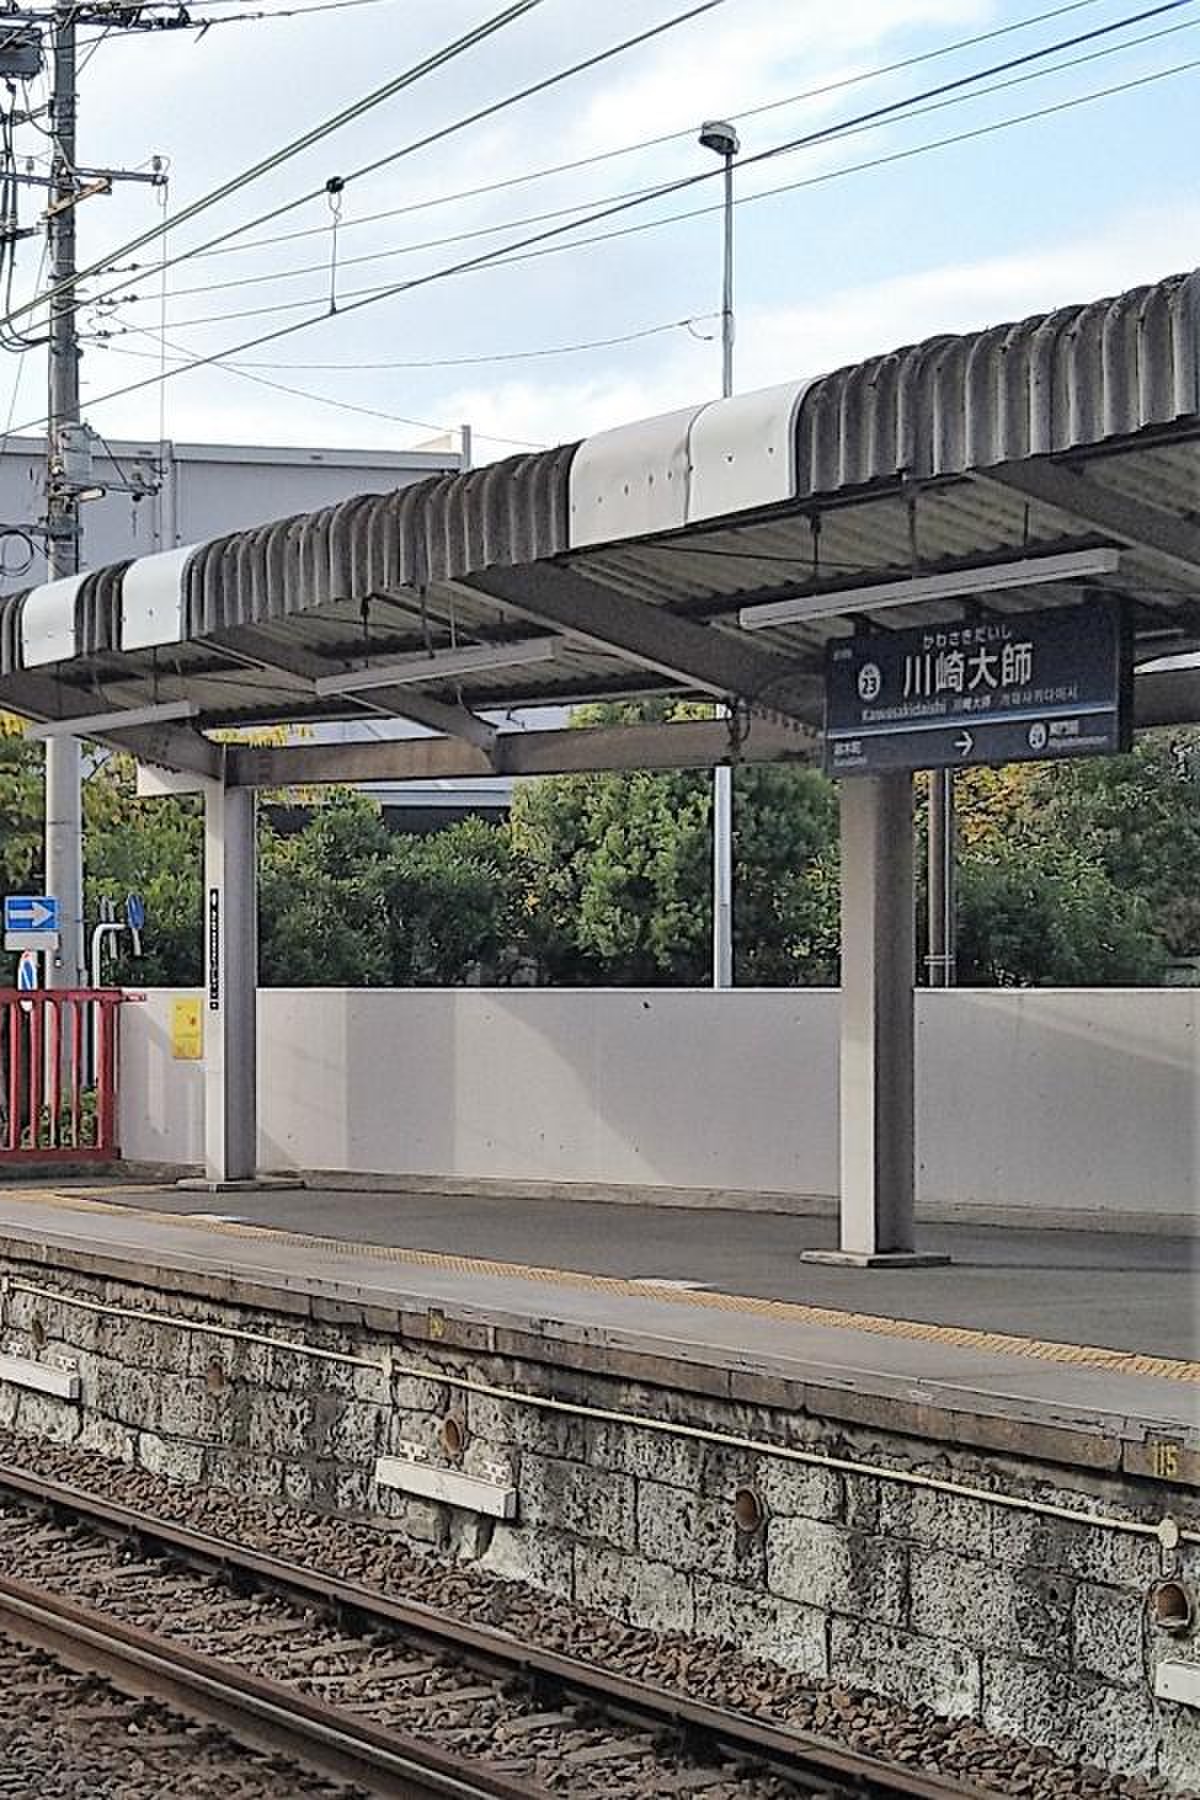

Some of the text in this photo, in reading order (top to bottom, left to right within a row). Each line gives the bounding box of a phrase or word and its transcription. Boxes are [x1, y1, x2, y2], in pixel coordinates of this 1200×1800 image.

[862, 677, 877, 694] 23
[903, 642, 1033, 698] 川崎大師
[1153, 1440, 1178, 1476] 115
